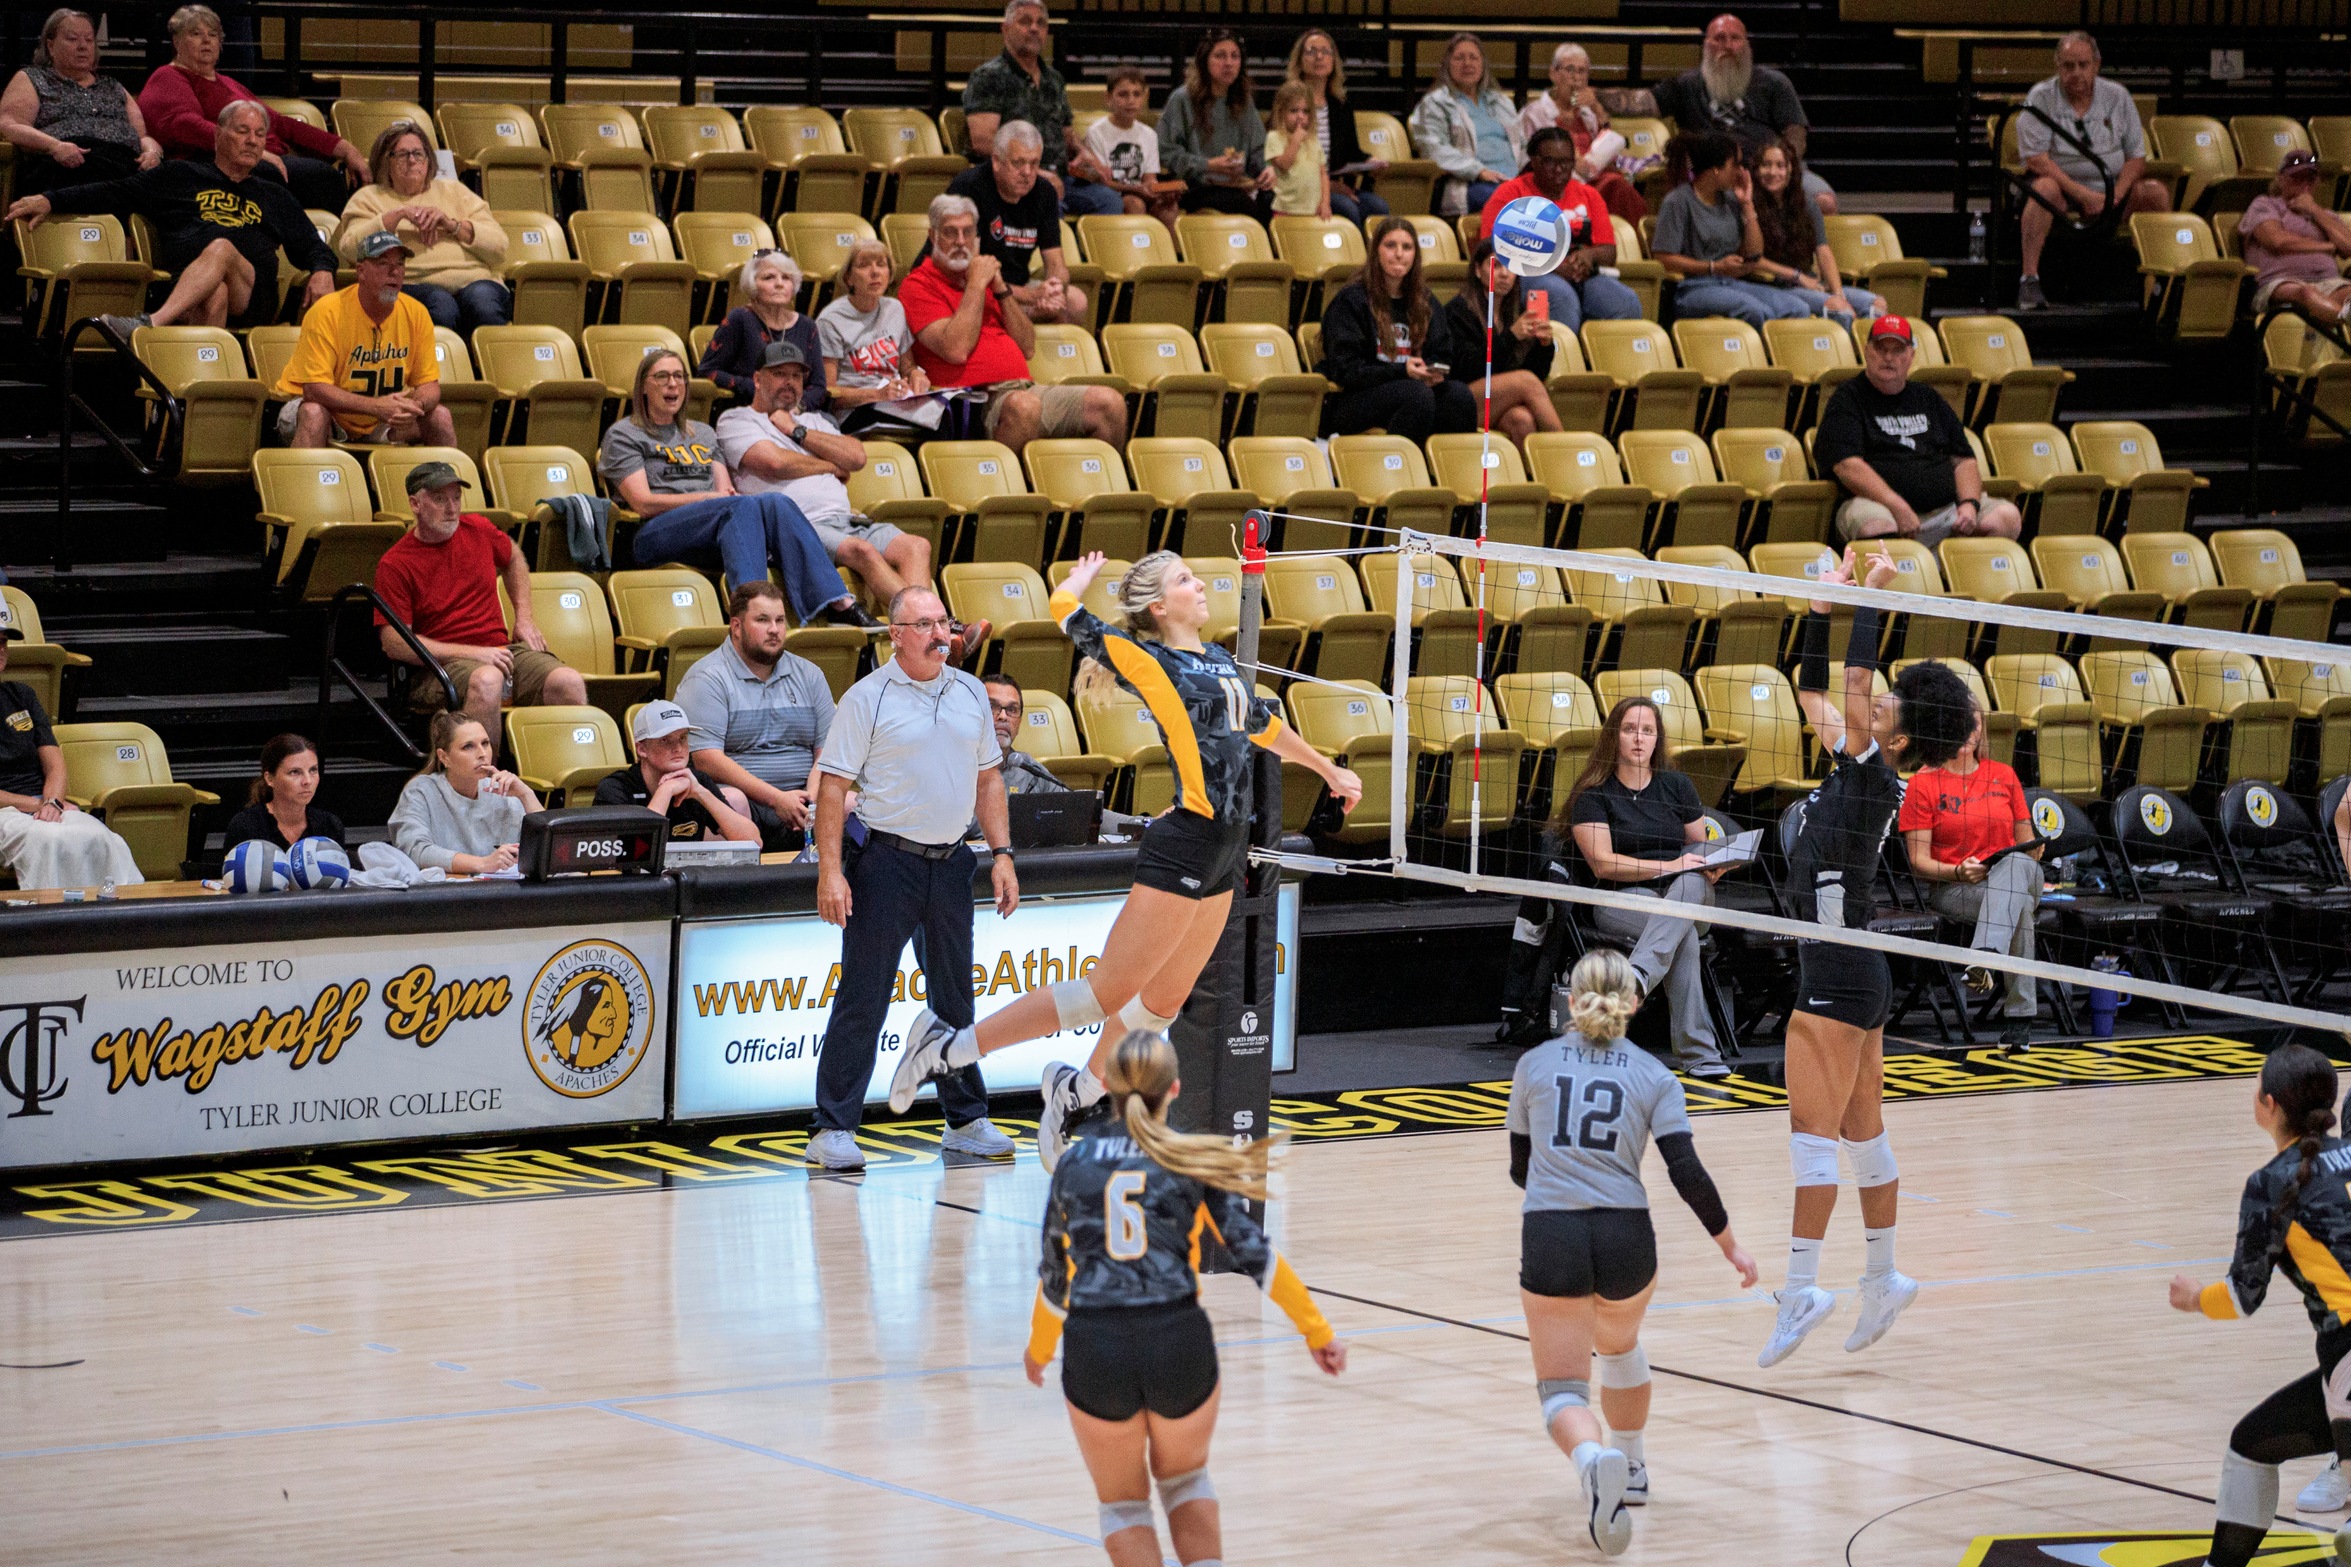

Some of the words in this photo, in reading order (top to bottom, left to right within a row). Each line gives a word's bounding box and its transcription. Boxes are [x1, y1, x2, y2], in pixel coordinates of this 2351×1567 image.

[499, 125, 511, 134] 34
[83, 230, 97, 240] 29
[525, 233, 539, 243] 33
[632, 233, 644, 243] 34
[736, 234, 748, 245] 35
[1502, 230, 1544, 250] molten
[840, 236, 852, 245] 36
[200, 350, 215, 360] 29
[537, 348, 551, 359] 32
[1061, 346, 1073, 355] 37
[1161, 346, 1175, 355] 38
[1289, 459, 1302, 469] 38
[1388, 458, 1400, 467] 39
[1579, 455, 1592, 463] 41
[982, 464, 995, 474] 35
[1085, 462, 1098, 471] 36
[1188, 460, 1199, 469] 37
[551, 470, 563, 480] 31
[879, 465, 891, 475] 34
[322, 473, 336, 483] 29
[1521, 573, 1534, 582] 39
[1217, 581, 1230, 590] 36
[1319, 579, 1332, 588] 37
[1006, 586, 1019, 595] 34
[563, 596, 577, 606] 30
[676, 594, 689, 604] 31
[1218, 677, 1249, 732] 11
[1454, 699, 1466, 709] 37
[1555, 695, 1568, 705] 38
[1350, 704, 1364, 713] 36
[1032, 714, 1046, 725] 33
[577, 731, 591, 741] 29
[120, 749, 135, 760] 28
[576, 840, 627, 858] POSS.
[116, 961, 248, 990] WELCOME
[256, 959, 294, 982] TO
[531, 972, 558, 1023] TYLER
[559, 948, 607, 975] JUNIOR
[92, 982, 370, 1095] Wagstaff
[382, 964, 513, 1048] Gym
[725, 1034, 804, 1066] Official
[1562, 1046, 1628, 1068] TYLER
[556, 1066, 620, 1090] APACHES
[200, 1103, 281, 1130] TYLER
[289, 1096, 381, 1124] JUNIOR
[389, 1088, 503, 1118] COLLEGE
[1550, 1074, 1626, 1153] 12
[1094, 1136, 1149, 1160] TYLE
[1104, 1170, 1148, 1261] 6
